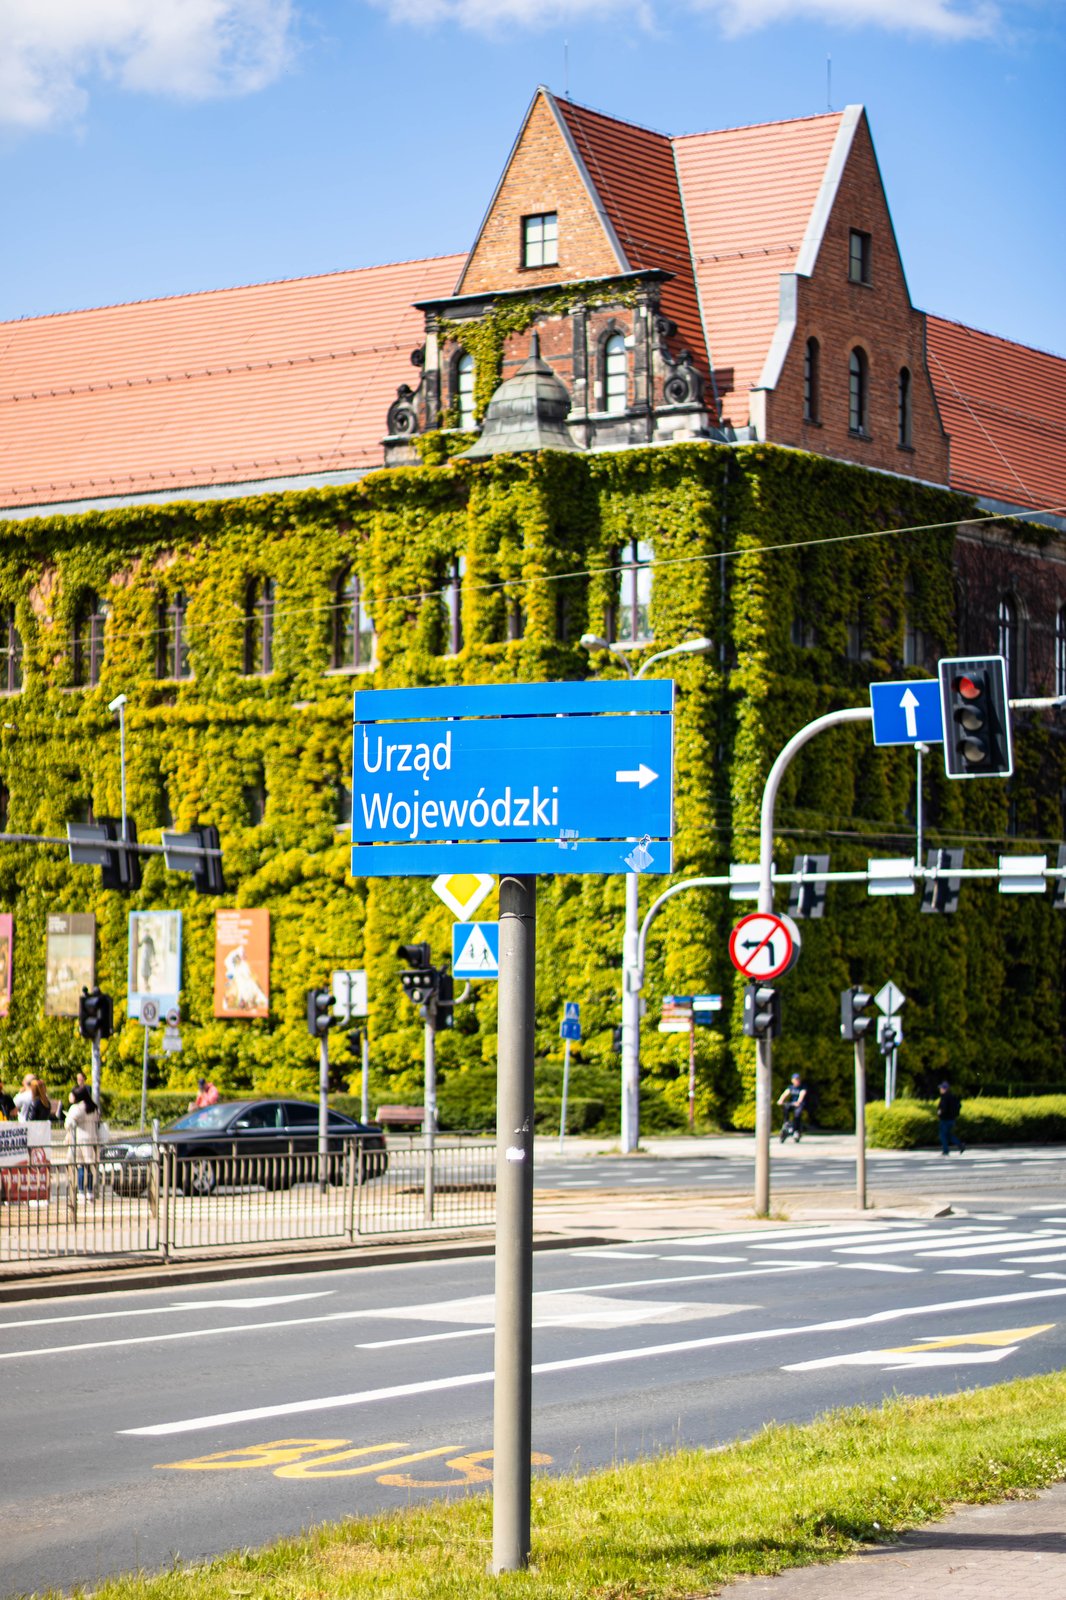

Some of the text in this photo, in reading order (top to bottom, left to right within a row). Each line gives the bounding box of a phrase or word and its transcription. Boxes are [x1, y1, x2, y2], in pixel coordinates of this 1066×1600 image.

[362, 730, 451, 781] Urząd
[361, 786, 559, 839] Wojewódzki
[0, 1127, 28, 1139] RZEGORZ
[152, 1438, 553, 1488] BUS
